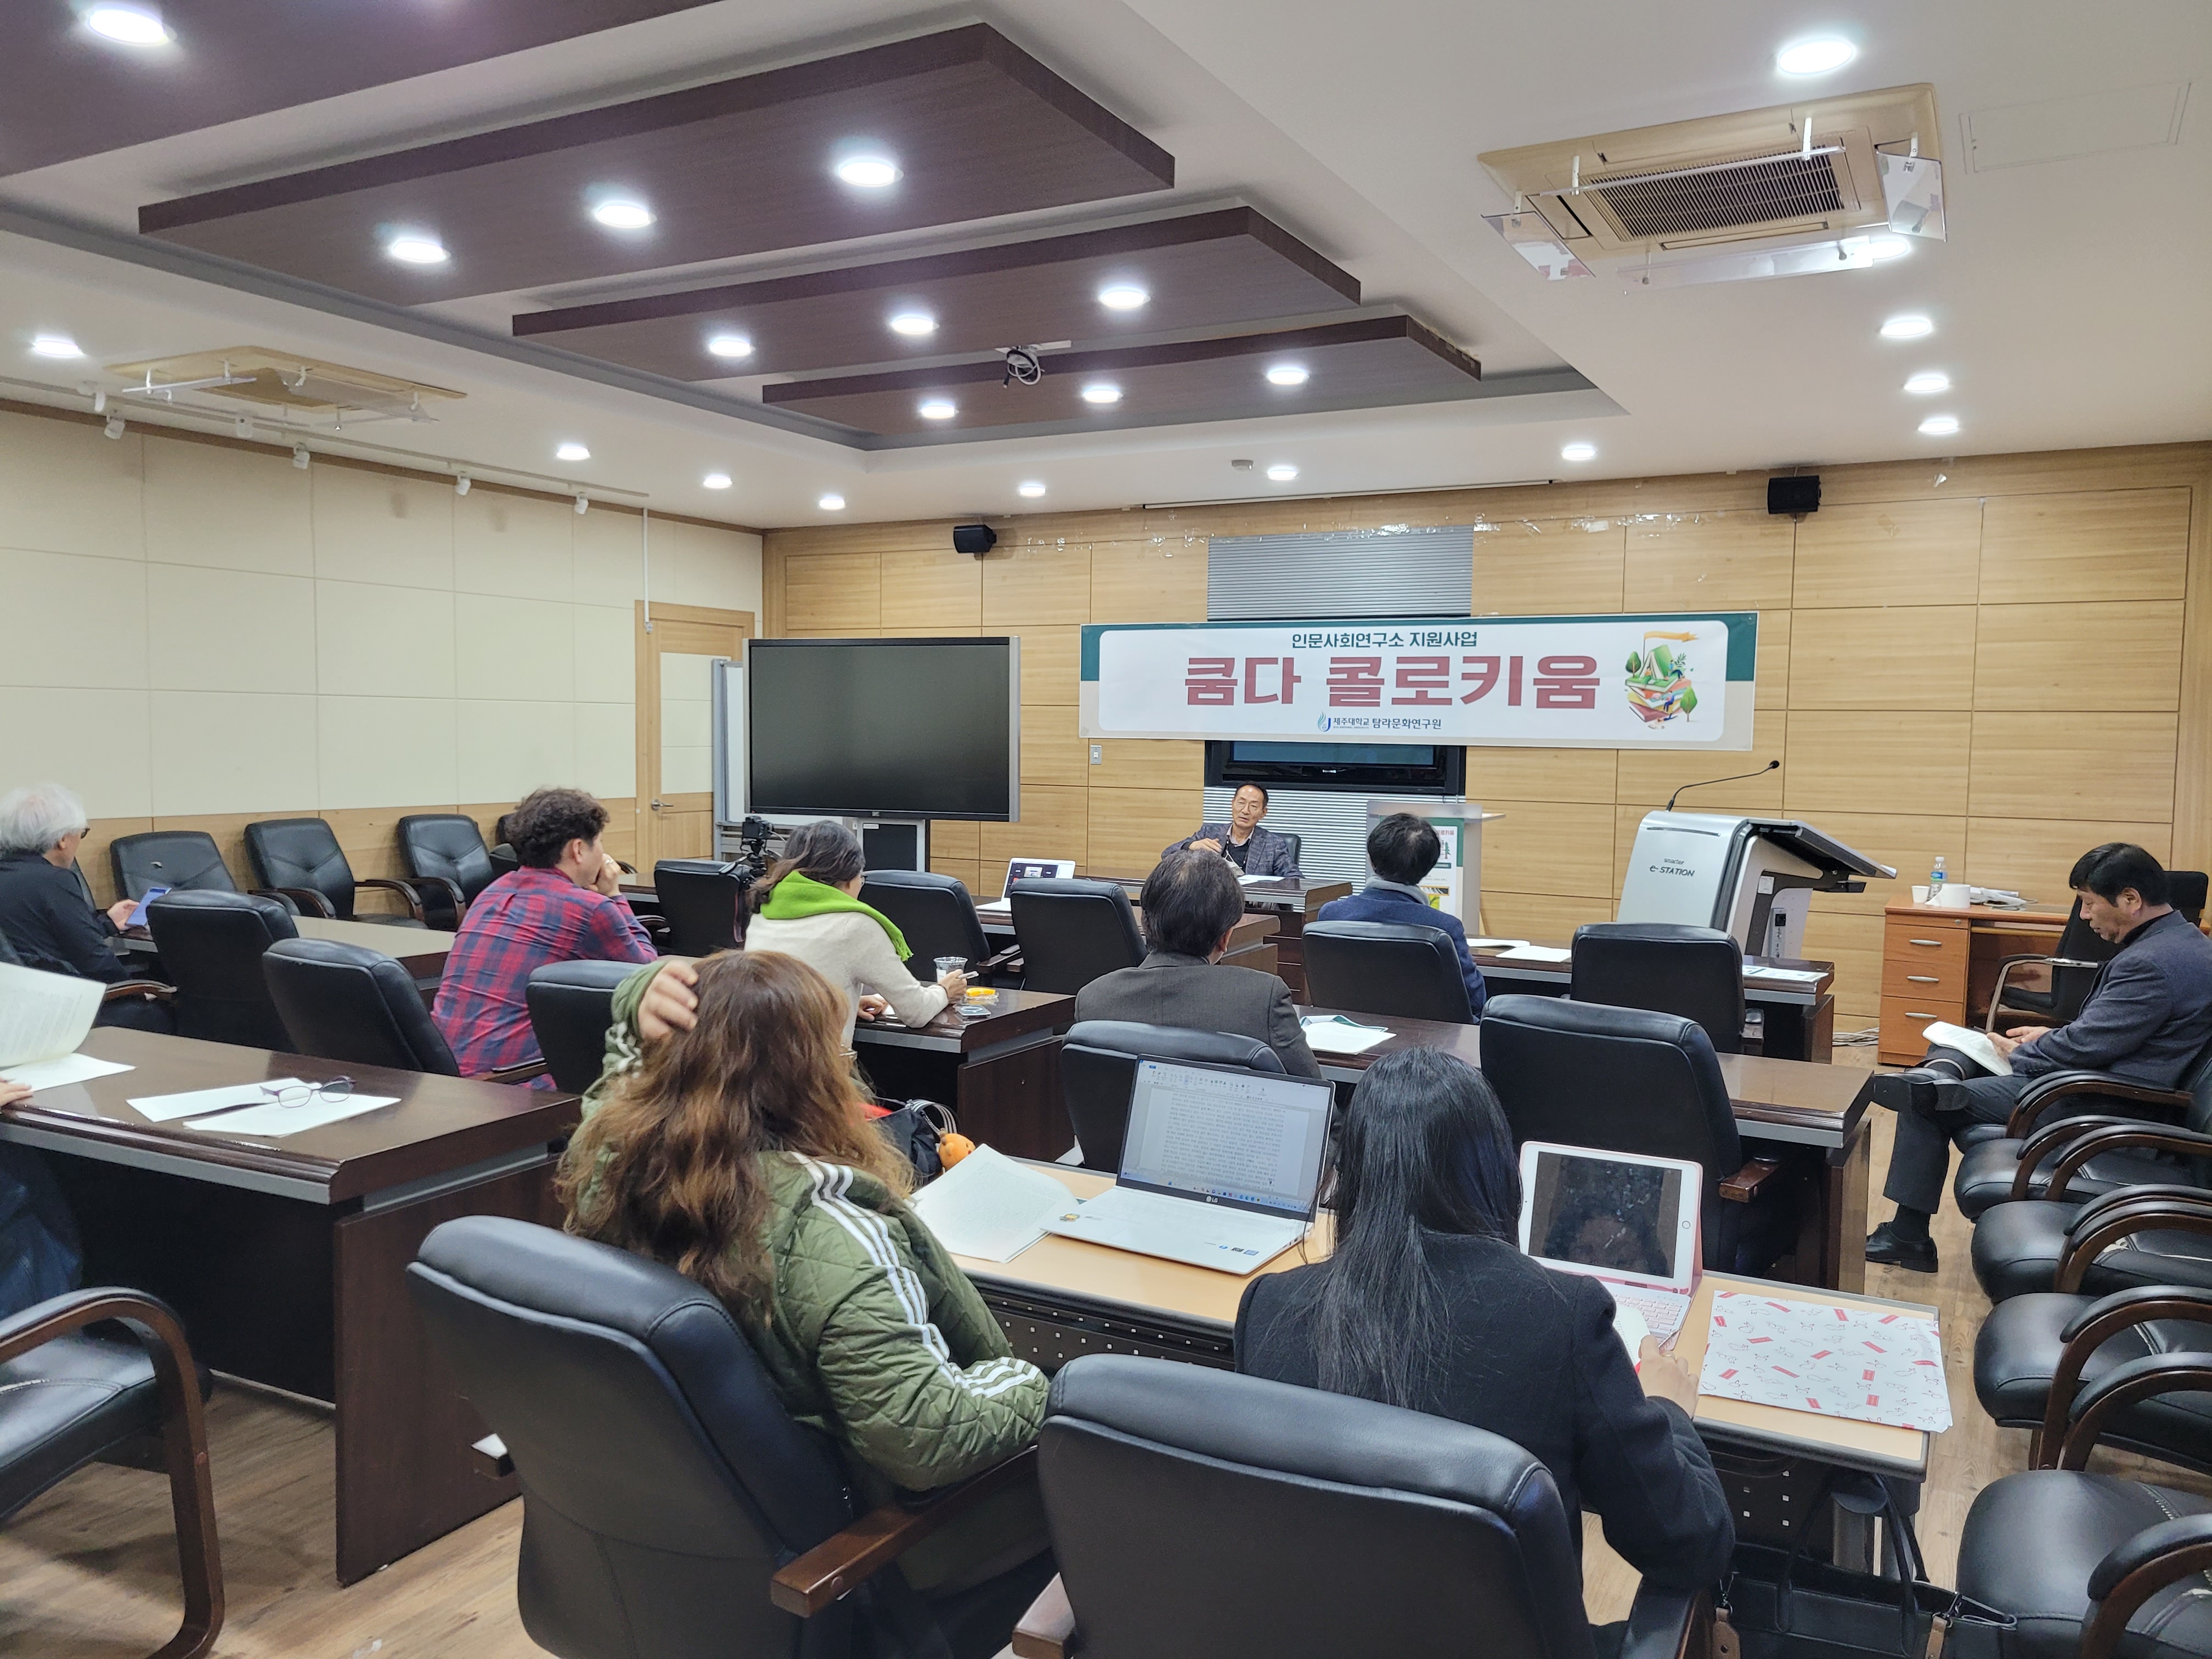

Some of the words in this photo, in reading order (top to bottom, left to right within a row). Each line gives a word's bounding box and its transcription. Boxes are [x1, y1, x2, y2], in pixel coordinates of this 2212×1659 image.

[1292, 633, 1404, 648] 인문사회연구소
[1409, 631, 1477, 647] 지원사업
[1186, 656, 1301, 706] 쿰다
[1326, 655, 1600, 708] 콜로키움
[1333, 718, 1369, 726] 제주대학교
[1372, 718, 1442, 730] 탐라문화연구원
